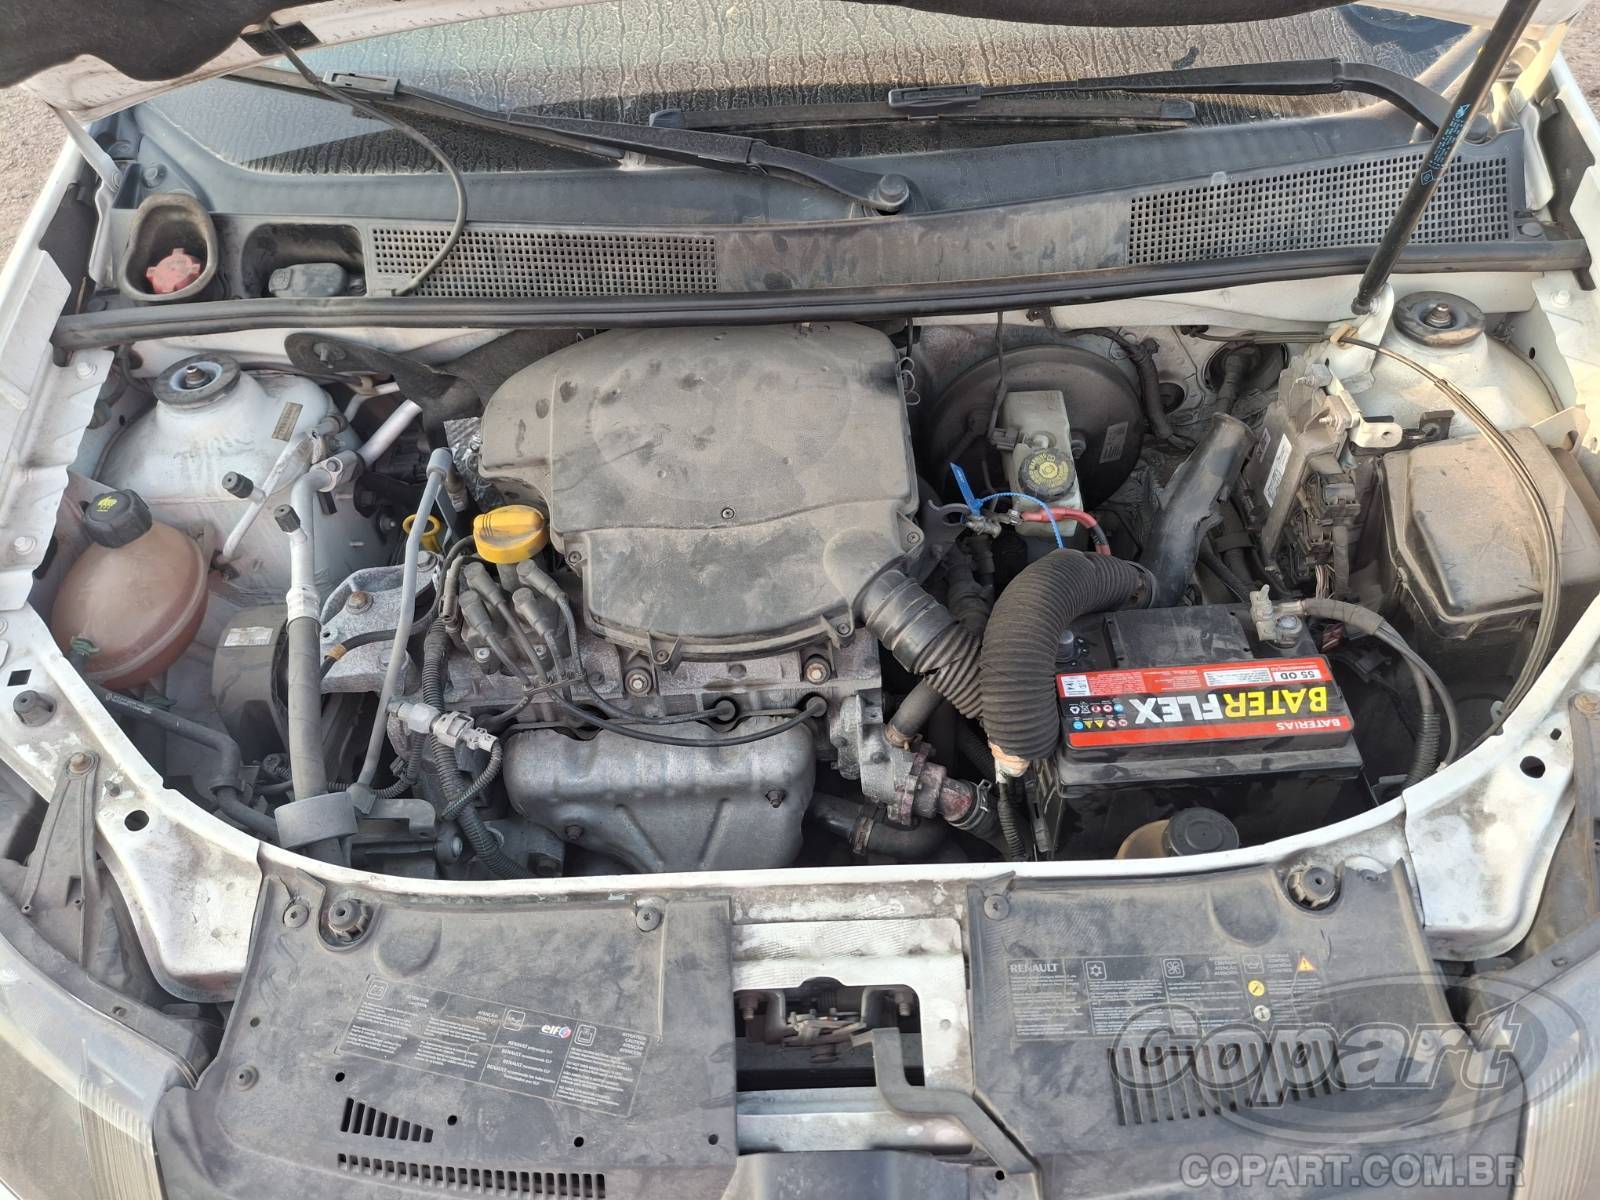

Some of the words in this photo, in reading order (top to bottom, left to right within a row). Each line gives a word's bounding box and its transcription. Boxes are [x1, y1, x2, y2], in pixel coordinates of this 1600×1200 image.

[1280, 671, 1298, 680] OD
[1301, 671, 1316, 679] 55
[1276, 718, 1342, 731] BATERIAS
[1009, 963, 1058, 973] RENAULT
[541, 1024, 560, 1037] elf
